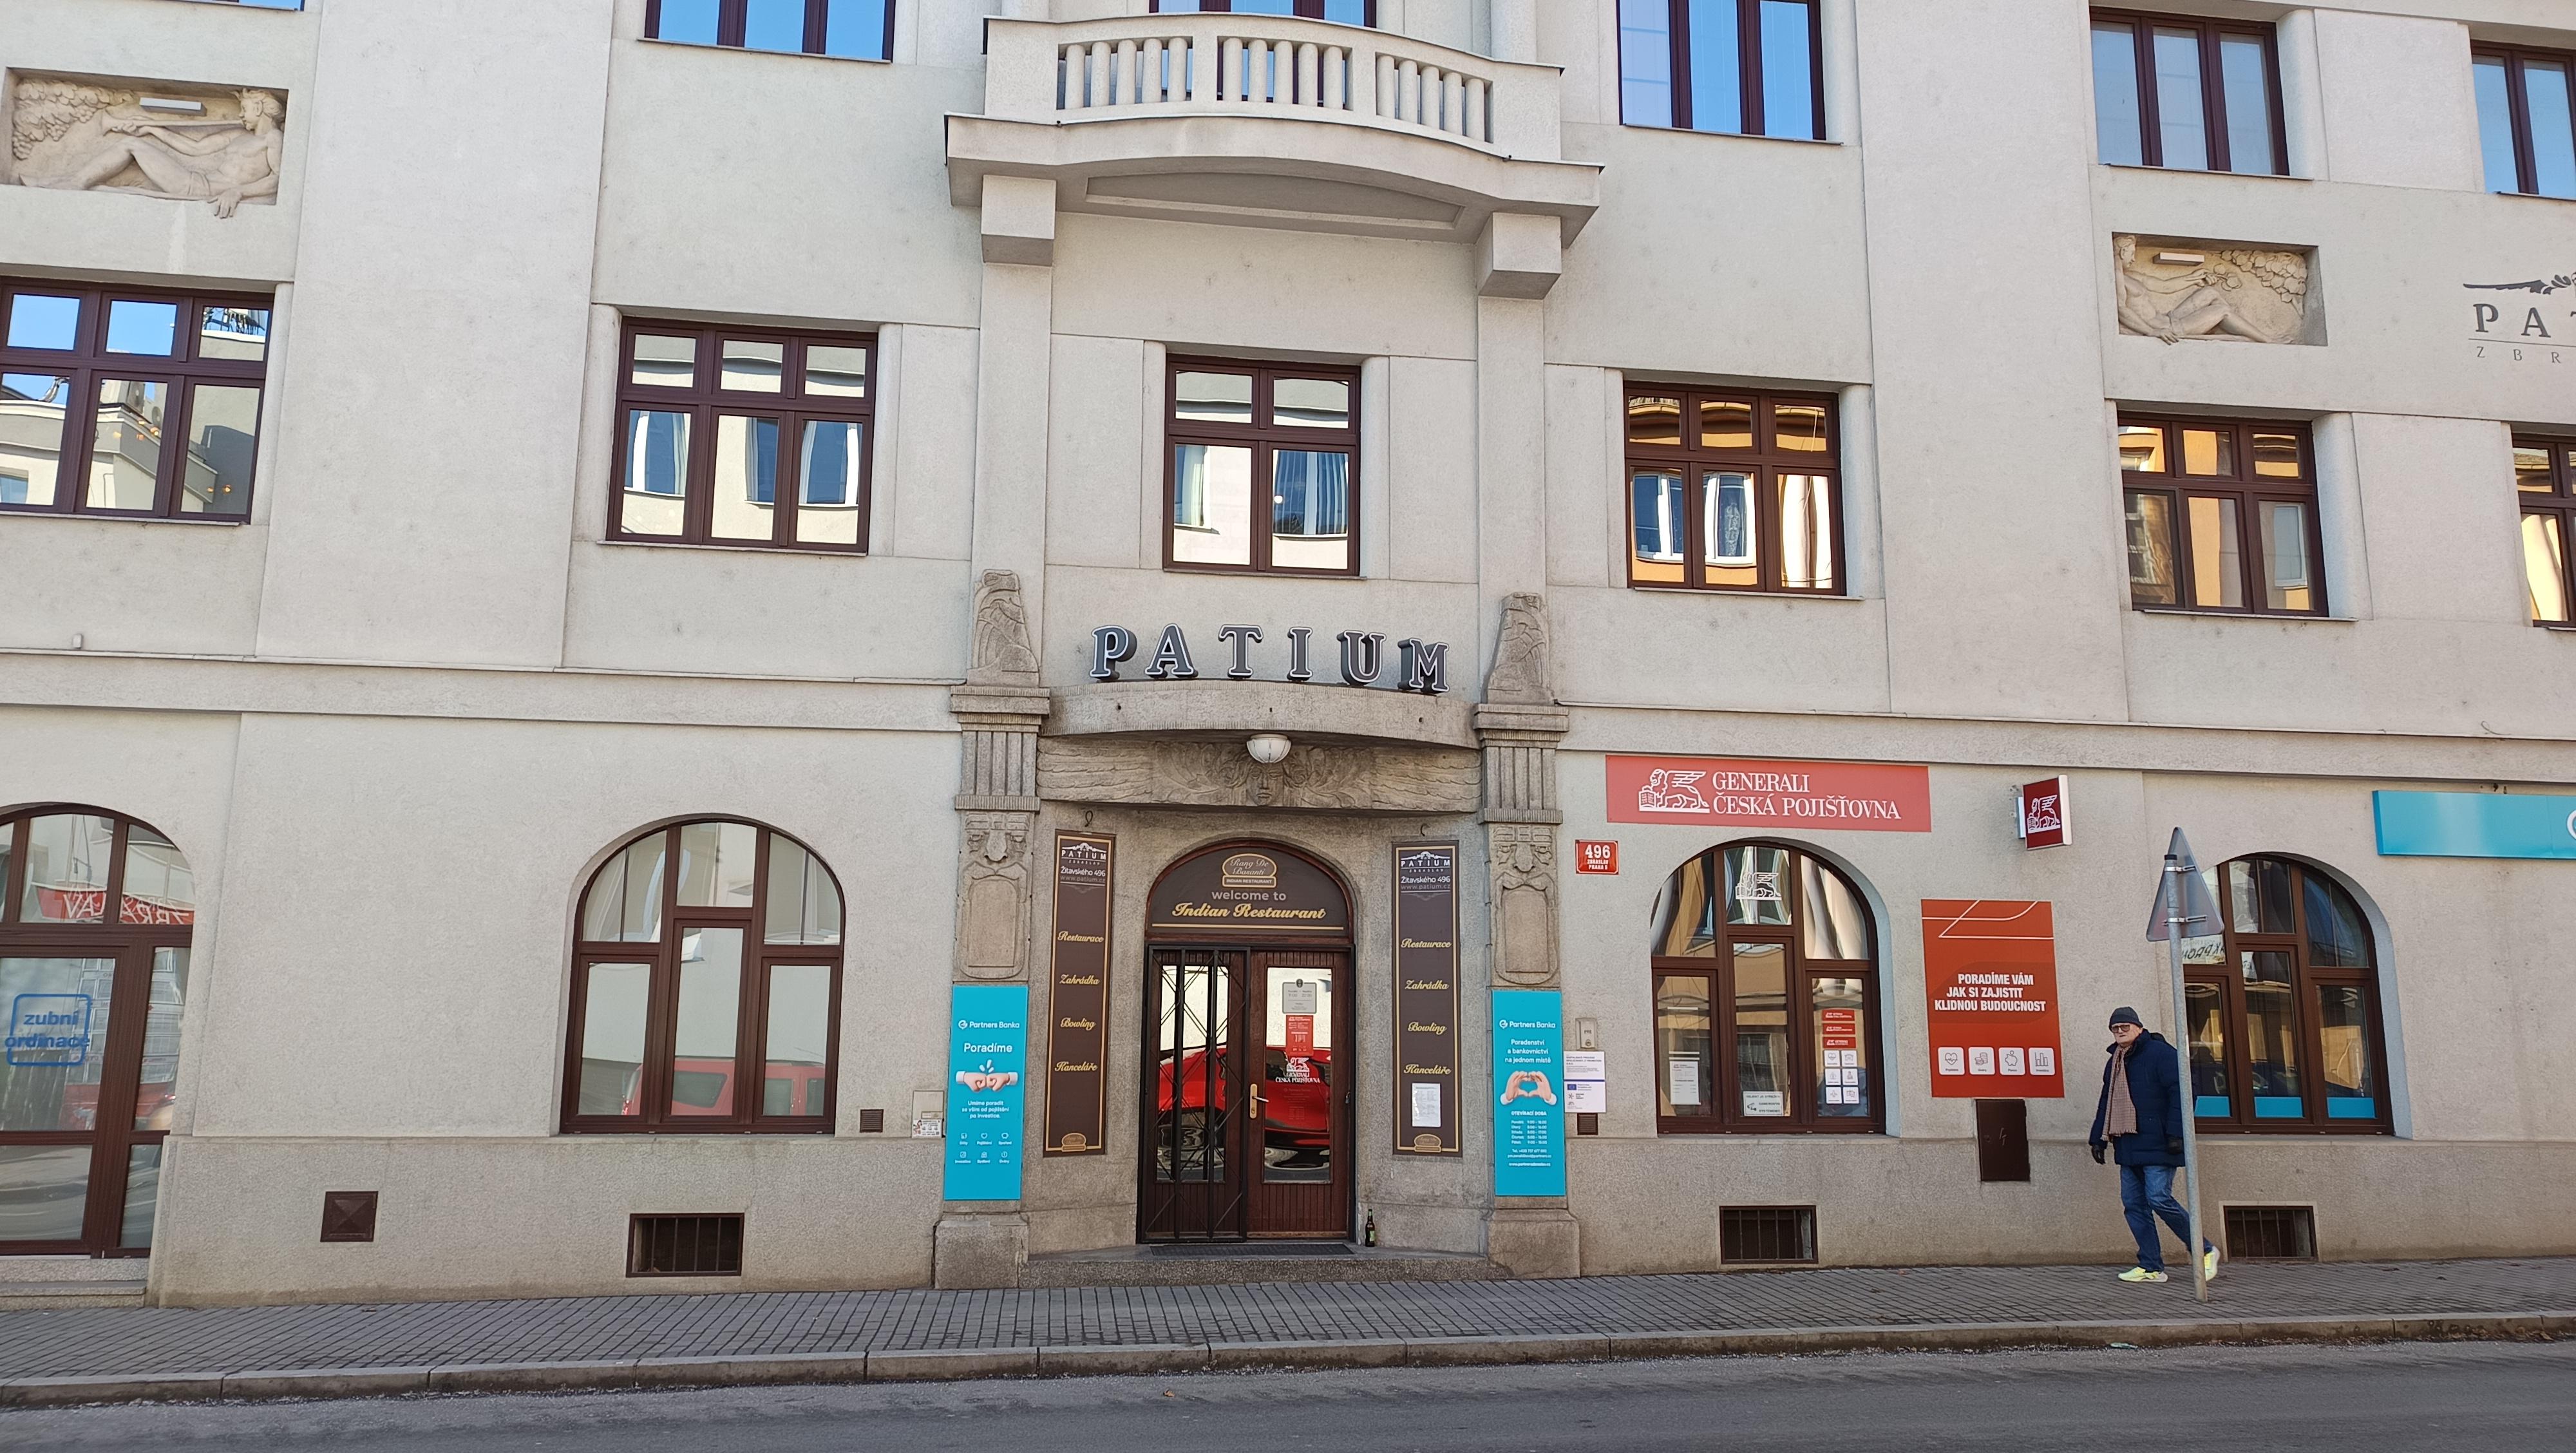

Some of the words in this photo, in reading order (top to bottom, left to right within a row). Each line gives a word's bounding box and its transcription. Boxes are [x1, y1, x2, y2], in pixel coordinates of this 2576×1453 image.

[2473, 303, 2576, 338] PA
[2476, 346, 2561, 364] ZBR
[1090, 623, 1450, 695] PATIUM
[1712, 772, 1810, 793] GENERALI
[1713, 792, 1777, 815] ČESKÁ
[1781, 795, 1902, 820] POJIŠŤOVNA
[1061, 850, 1106, 860] PATIUM
[1585, 844, 1611, 859] 496
[1230, 858, 1254, 869] Rang
[1256, 859, 1269, 867] De
[1061, 866, 1093, 876] Žitavského
[1211, 889, 1269, 901] welcome
[1273, 891, 1287, 901] to
[1172, 902, 1230, 917] Indian
[1233, 903, 1327, 919] Restaurant
[1057, 931, 1104, 942] Restaurace
[1401, 938, 1452, 948] Restaurace
[1059, 974, 1100, 985] Zahrádka
[1958, 971, 2011, 985] PORADÍME
[2011, 972, 2034, 985] VÁM
[1405, 980, 1449, 990] Zahrádka
[1946, 987, 1966, 998] JAK
[1968, 987, 1978, 998] SI
[1980, 987, 2023, 998] ZAJISTIT
[1935, 1000, 1978, 1011] KLIDNOU
[1980, 1000, 2046, 1012] BUDOUCNOST
[23, 1009, 79, 1025] zubní
[1061, 1017, 1096, 1030] Bowling
[1407, 1021, 1447, 1035] Bowling
[5, 1034, 90, 1049] ordinace
[963, 1042, 1012, 1052] Poradíme
[1055, 1061, 1097, 1072] Kanceláře
[1403, 1064, 1451, 1075] Kanceláře
